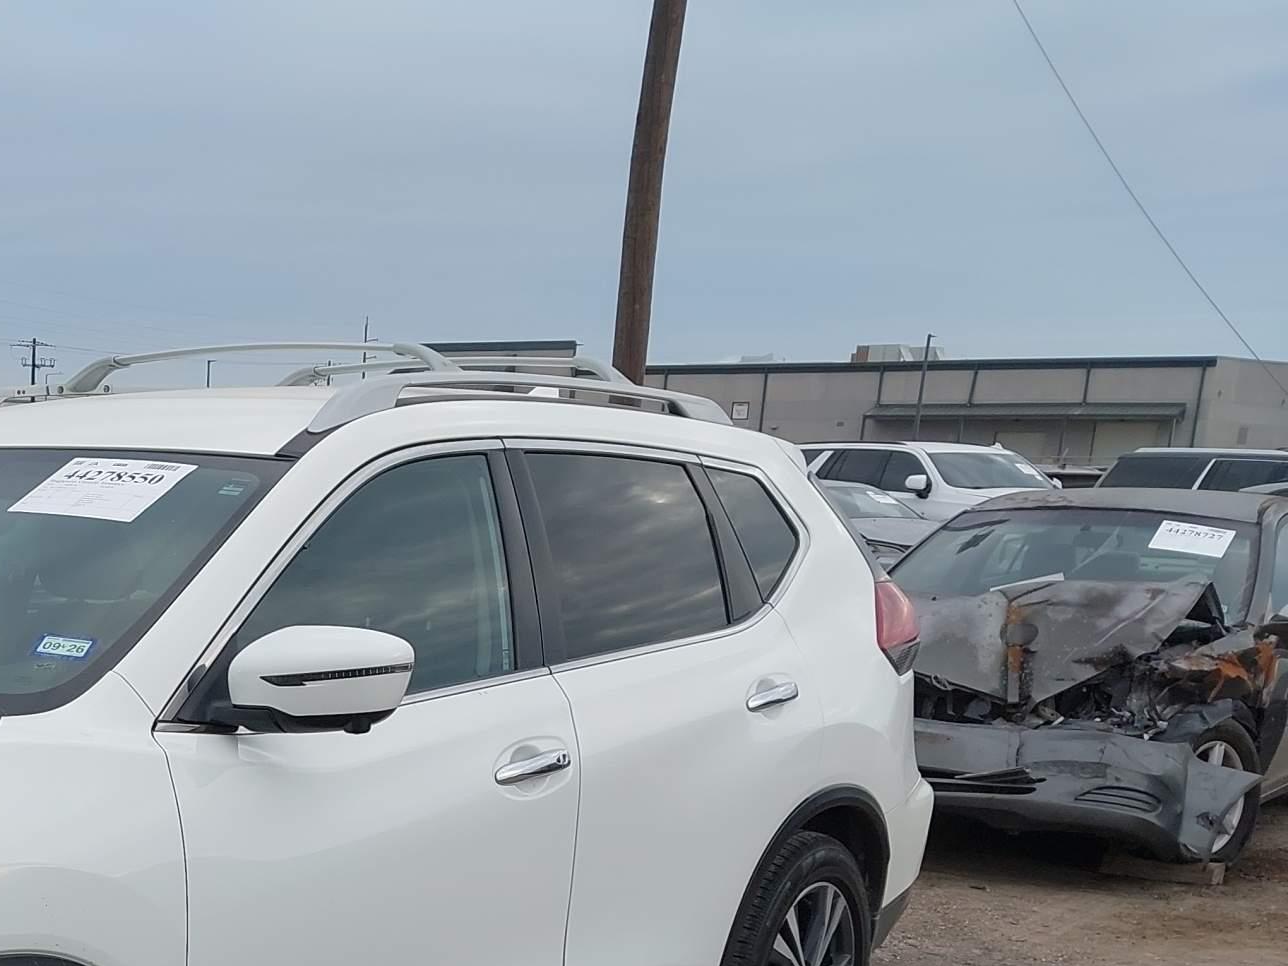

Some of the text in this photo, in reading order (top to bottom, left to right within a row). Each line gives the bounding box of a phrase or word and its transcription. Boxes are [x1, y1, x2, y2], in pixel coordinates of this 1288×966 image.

[64, 469, 165, 485] 44278550
[42, 641, 86, 654] 09 26
